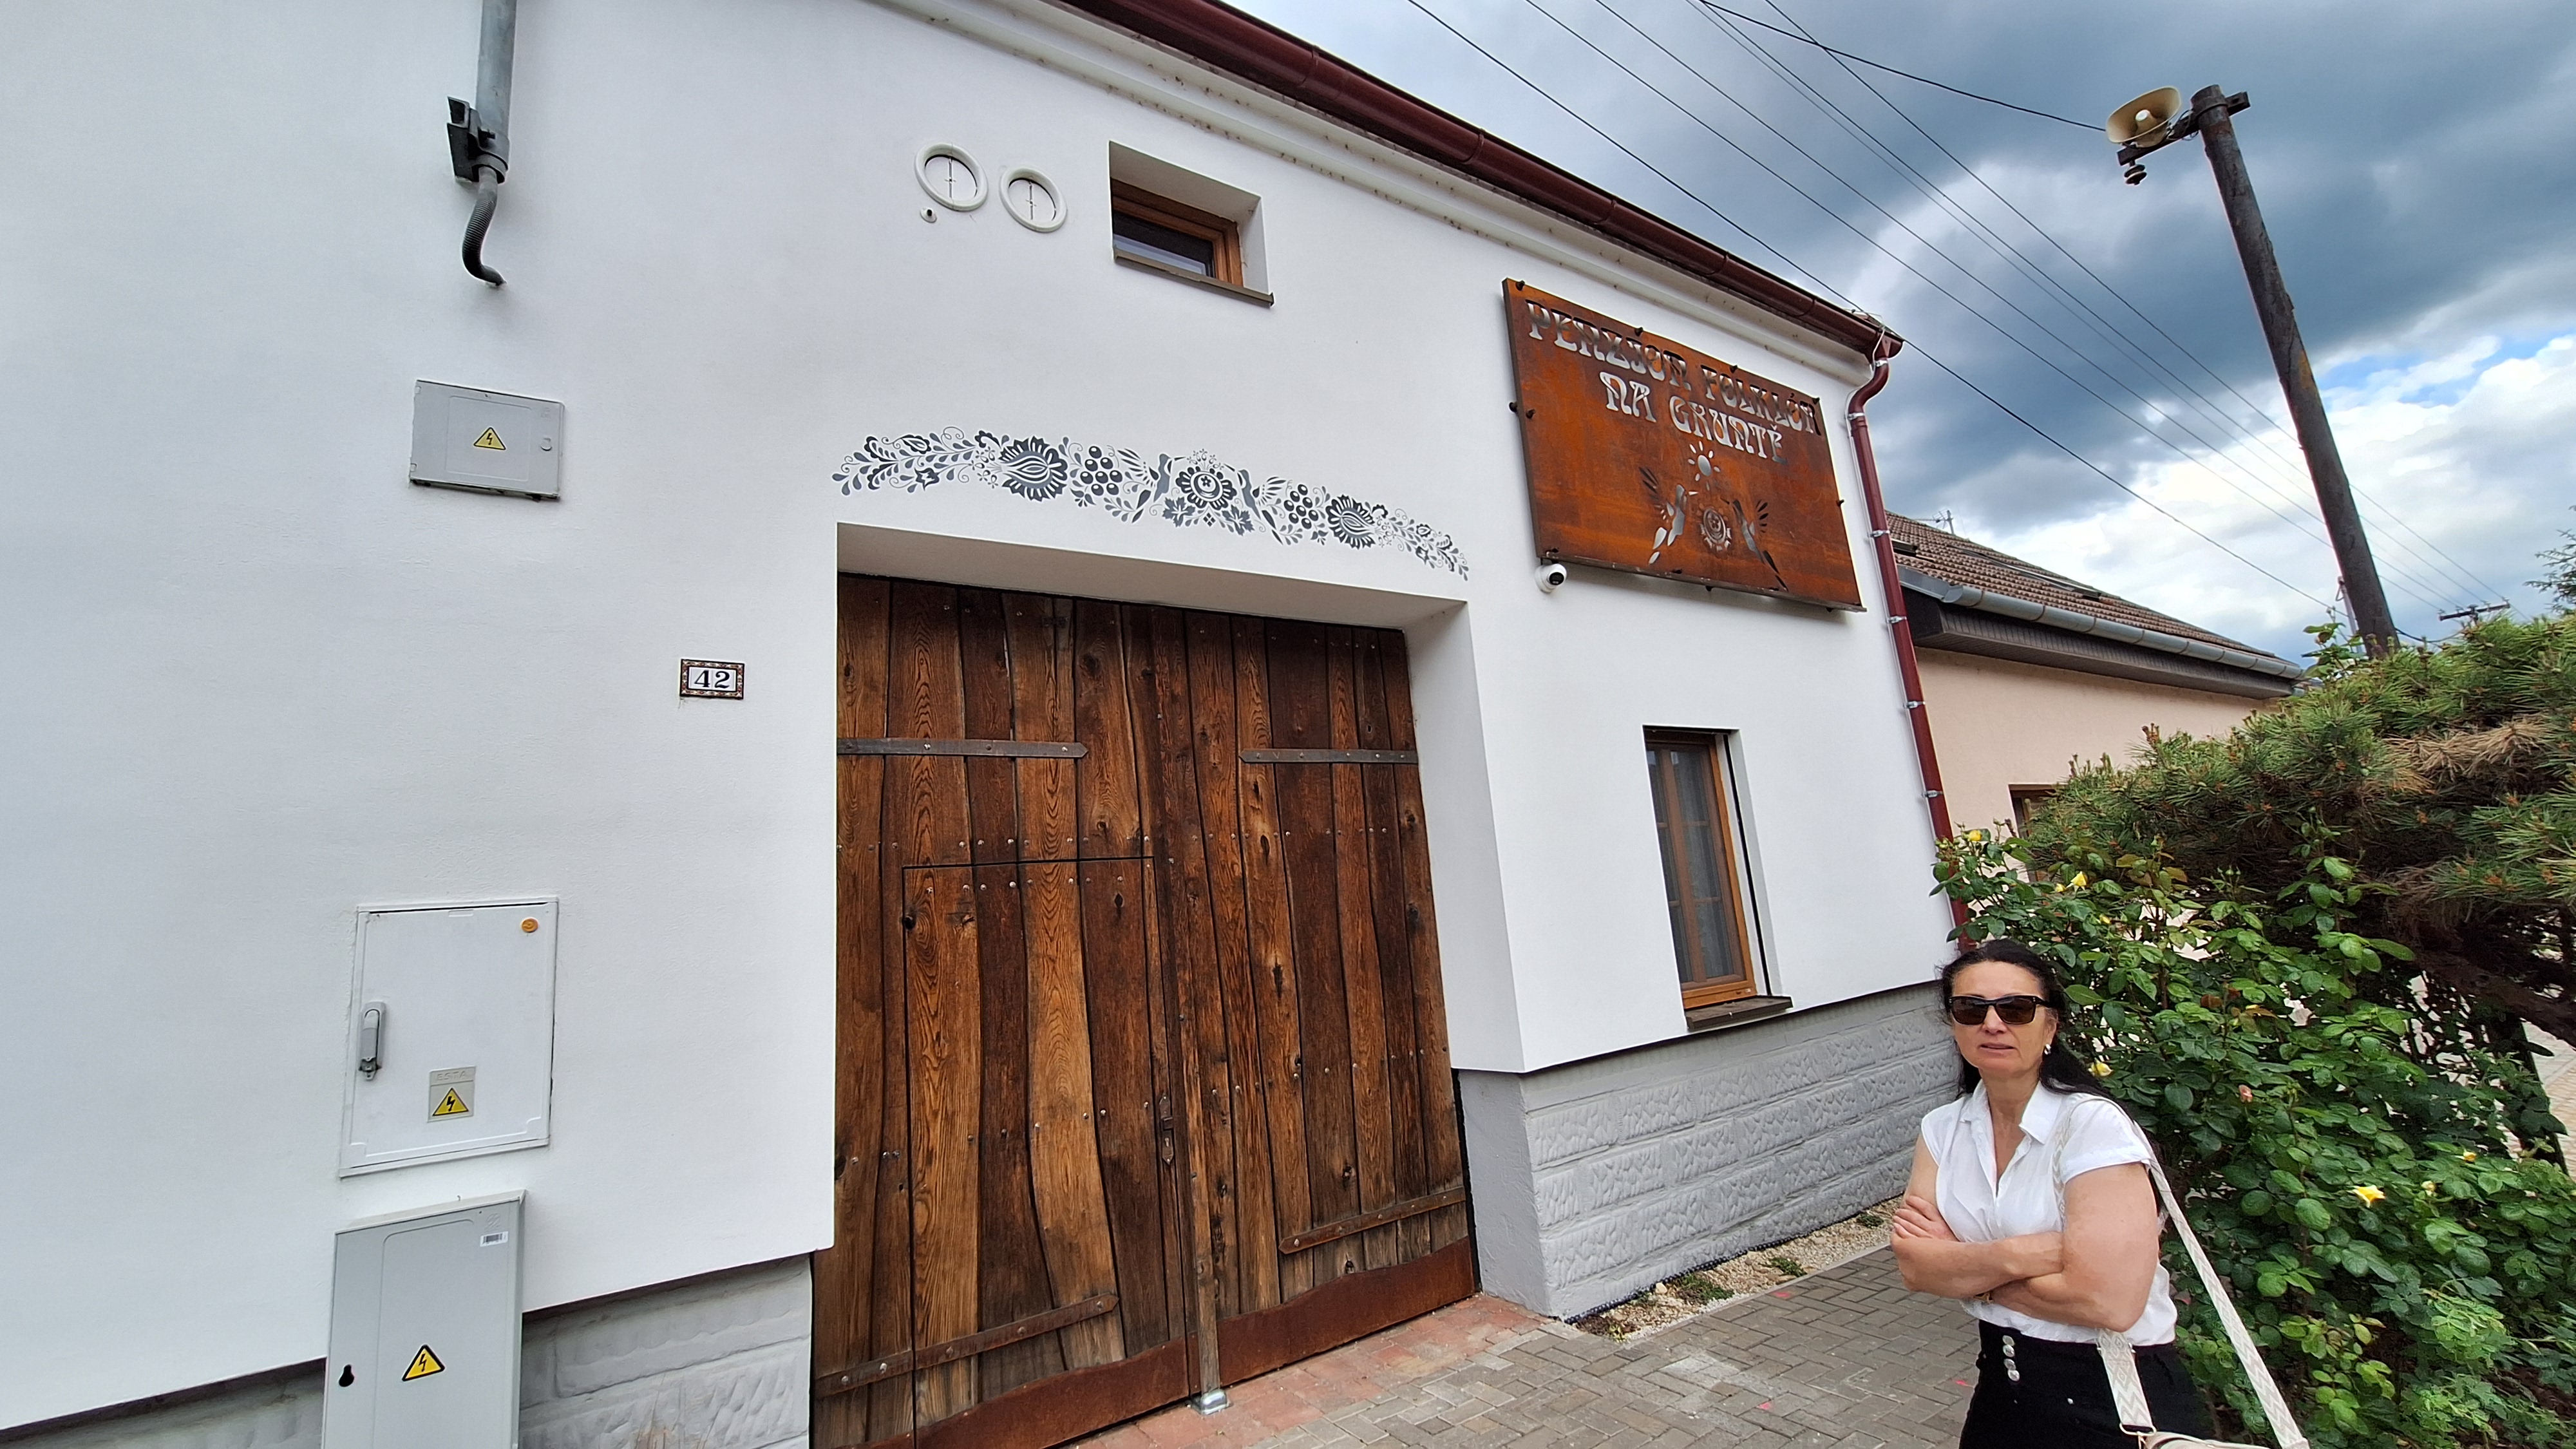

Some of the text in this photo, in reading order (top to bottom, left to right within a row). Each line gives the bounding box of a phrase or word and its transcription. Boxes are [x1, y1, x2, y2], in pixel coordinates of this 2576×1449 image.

[1600, 372, 1788, 466] NA GRUNTĚ
[1701, 365, 1821, 436] FOLKLÓR
[694, 670, 730, 689] 42
